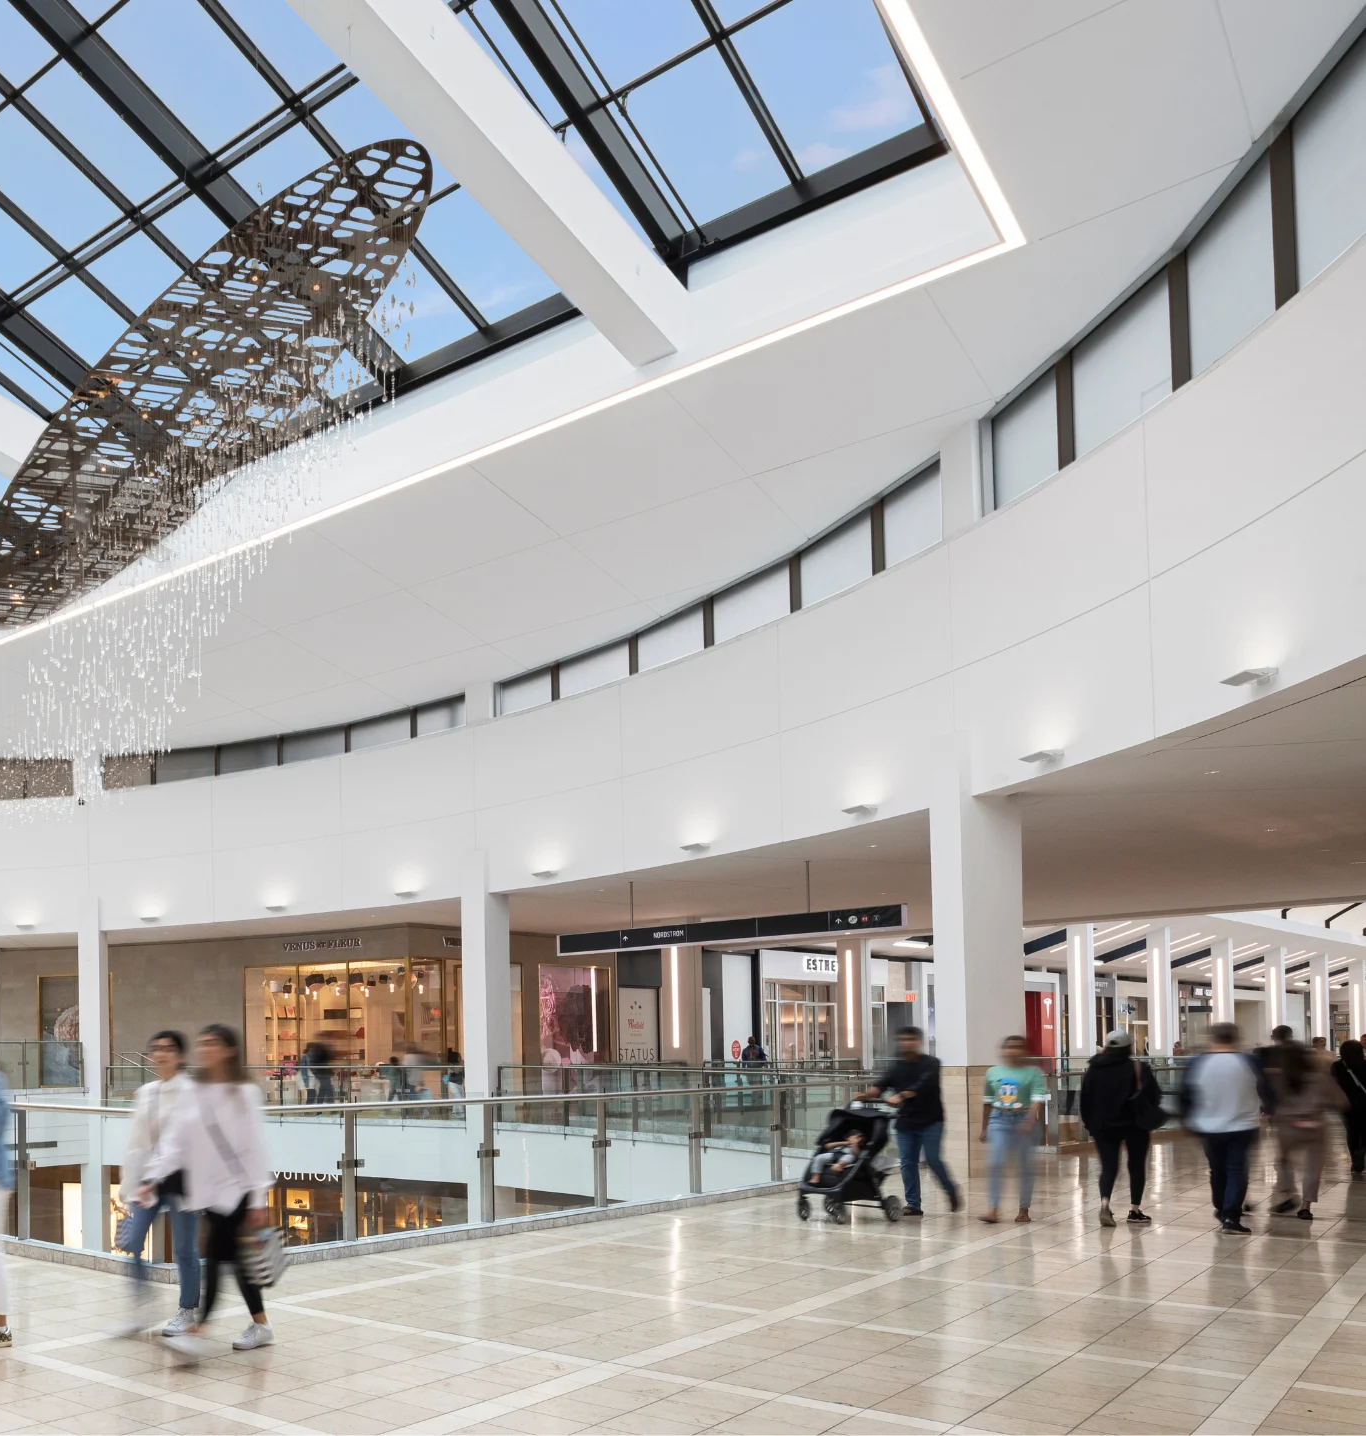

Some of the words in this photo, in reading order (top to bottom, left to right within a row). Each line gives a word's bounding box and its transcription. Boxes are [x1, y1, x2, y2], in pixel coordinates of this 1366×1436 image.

[653, 929, 684, 939] NORDSTROM
[283, 940, 317, 952] VENUS
[328, 936, 362, 950] FLEUR
[619, 1047, 655, 1061] STATUS
